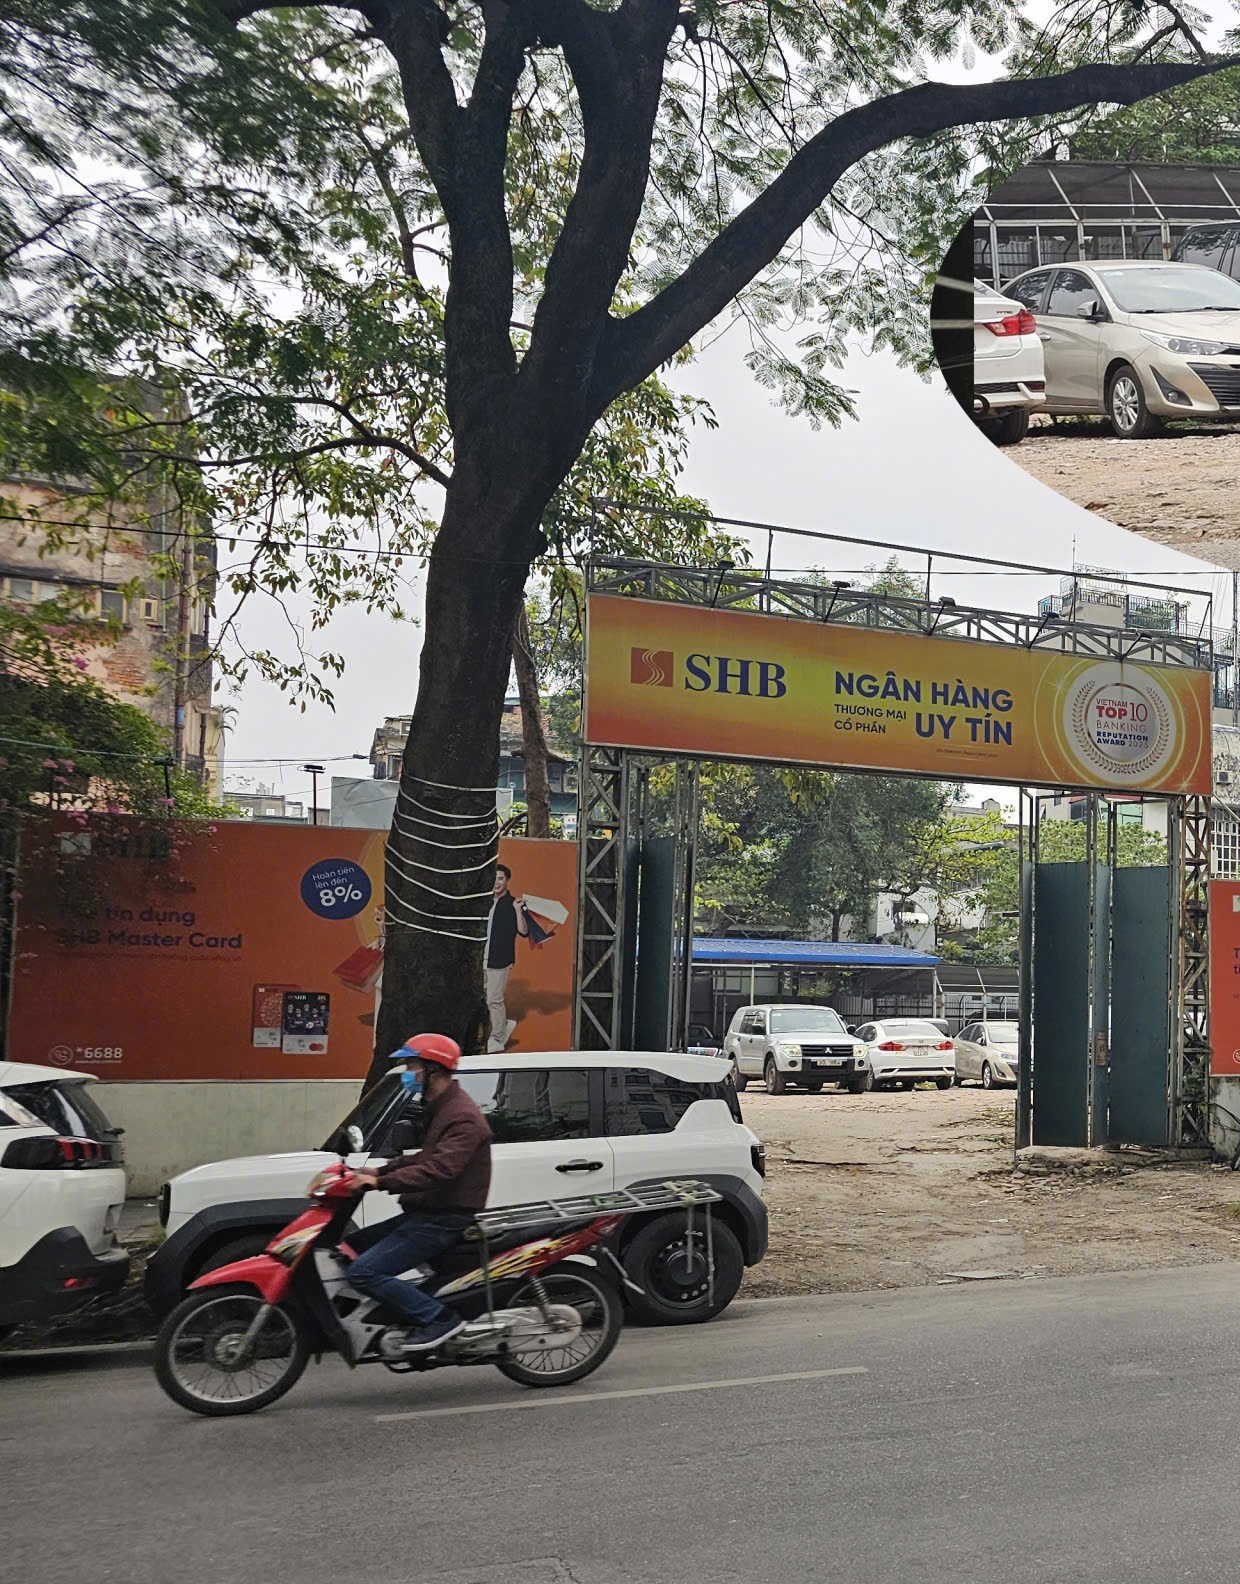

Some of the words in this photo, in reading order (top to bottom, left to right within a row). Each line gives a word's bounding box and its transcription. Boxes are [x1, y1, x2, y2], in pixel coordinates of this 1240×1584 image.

[685, 653, 787, 698] SHB
[835, 670, 921, 703] NGÂN
[931, 678, 1013, 712] HÀNG
[1096, 698, 1127, 708] VIETNAM
[1096, 705, 1128, 720] TOP
[1130, 702, 1147, 722] 10
[834, 704, 883, 717] THƯƠNG
[886, 709, 907, 722] MẠI
[834, 717, 852, 731] CỔ
[855, 720, 886, 734] PHẦN
[915, 712, 957, 740] UY
[965, 713, 1012, 746] TÍN
[1096, 720, 1146, 733] BANKING
[1096, 731, 1148, 741] REPUTATION
[1096, 738, 1126, 746] AWARD
[312, 869, 336, 881] Hoàn
[315, 880, 330, 889] lên
[330, 876, 348, 887] đến
[319, 883, 363, 907] 8%
[139, 906, 195, 926] dụng
[108, 930, 183, 948] Master
[189, 932, 242, 949] Card
